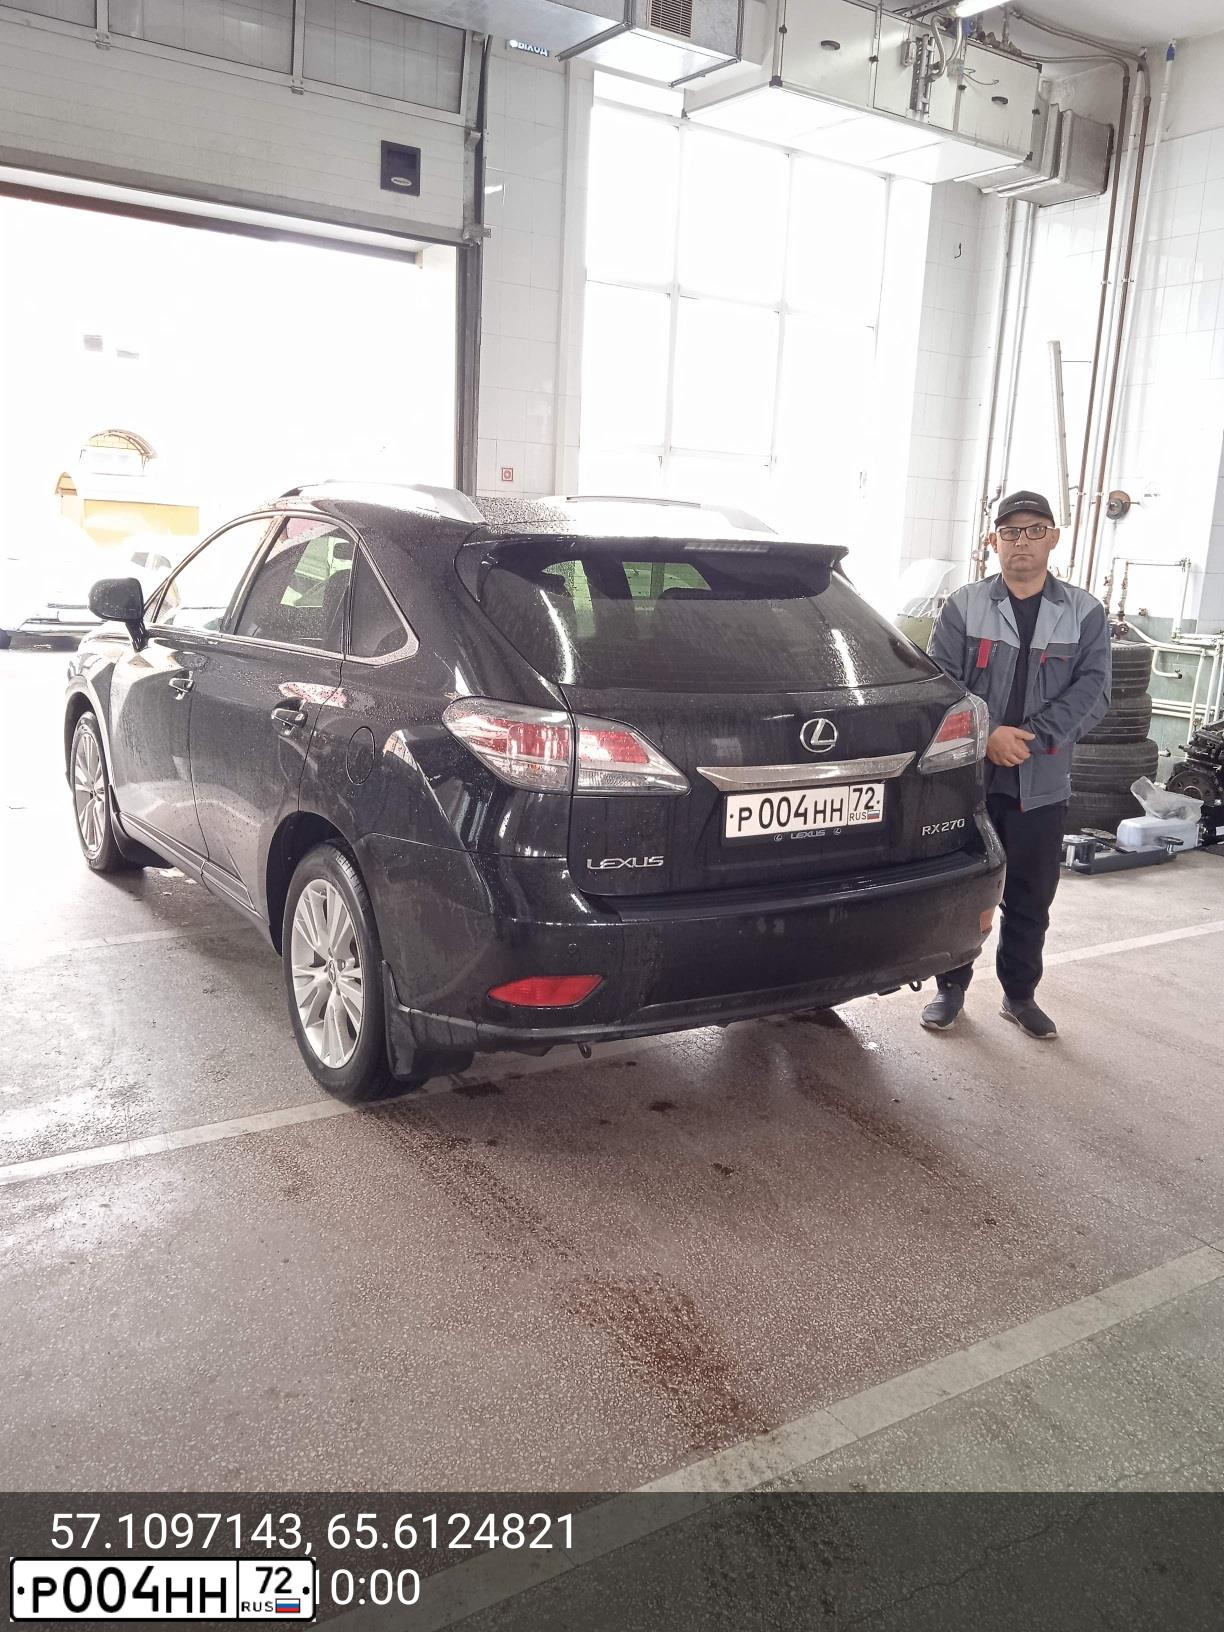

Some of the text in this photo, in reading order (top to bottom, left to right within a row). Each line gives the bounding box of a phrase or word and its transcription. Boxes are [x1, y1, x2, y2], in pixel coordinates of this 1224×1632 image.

[852, 786, 876, 812] 72
[849, 810, 867, 822] RUS
[790, 829, 826, 840] LEXUS
[586, 855, 665, 870] LEXUS
